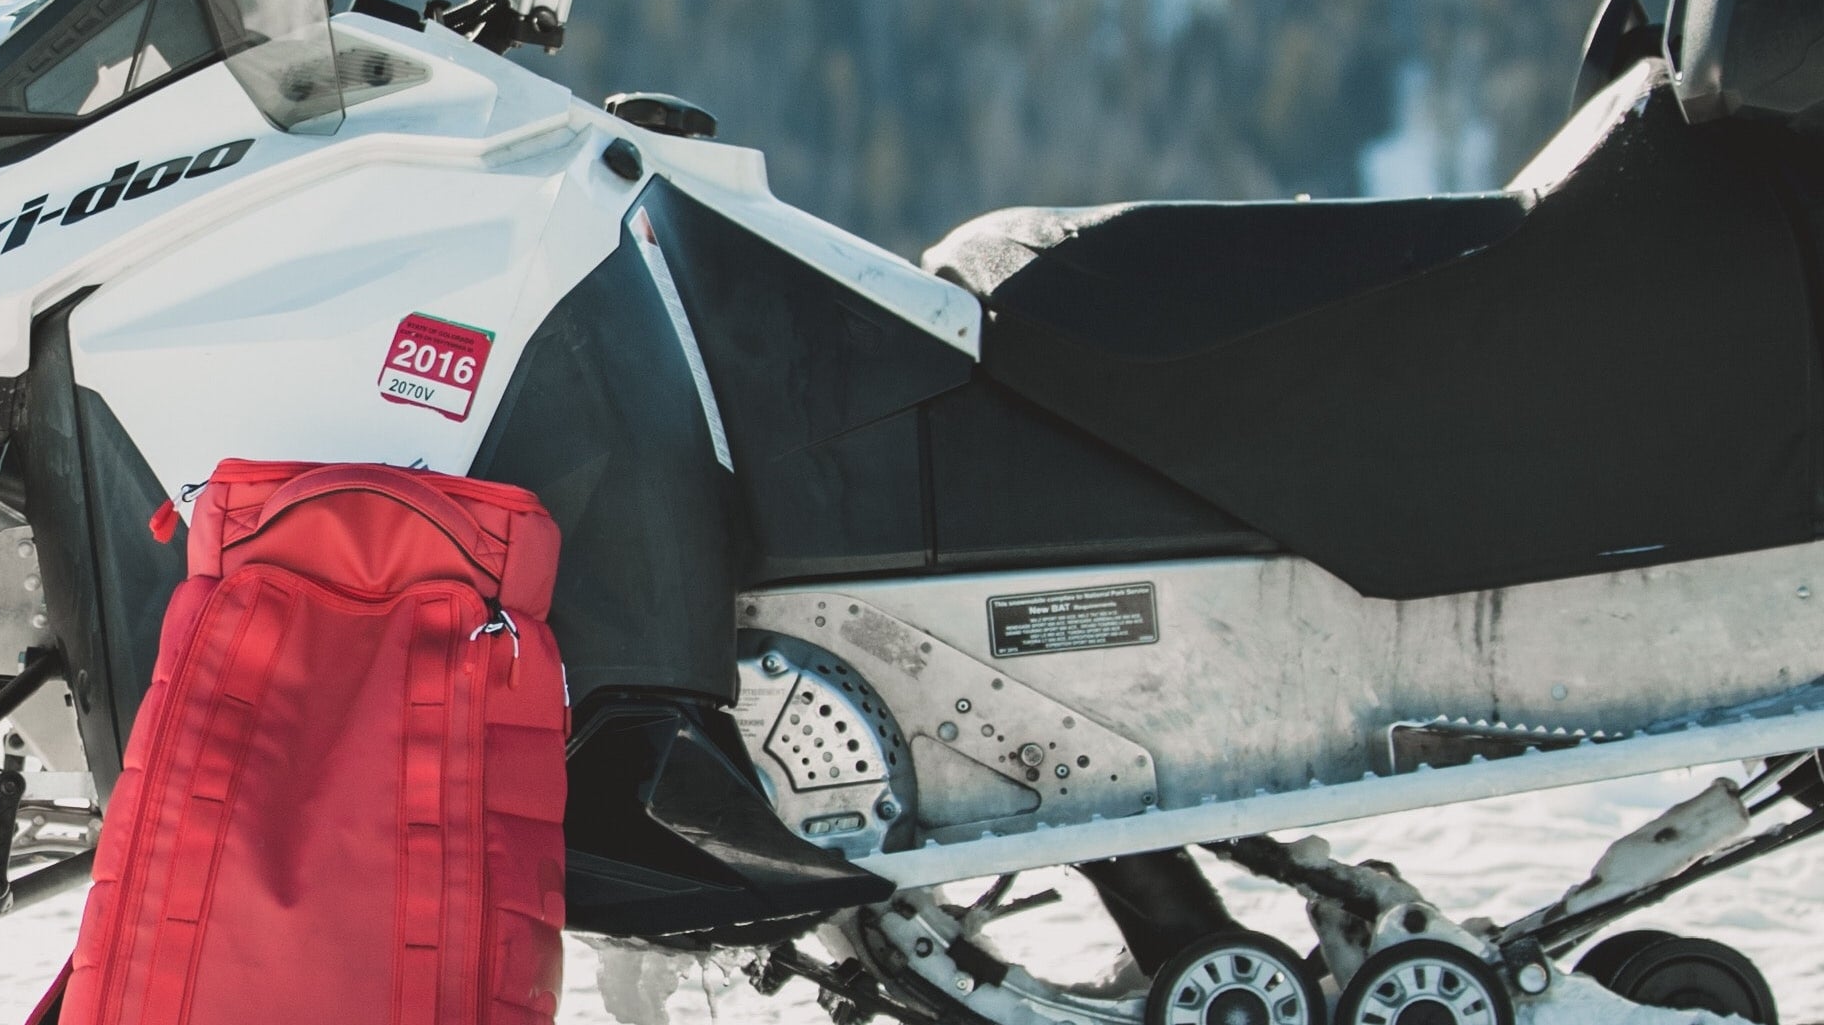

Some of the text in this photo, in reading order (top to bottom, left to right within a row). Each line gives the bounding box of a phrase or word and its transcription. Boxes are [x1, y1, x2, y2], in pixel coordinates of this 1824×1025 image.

[439, 330, 474, 344] COLORADO
[392, 340, 476, 384] 2016
[389, 379, 435, 401] 2070V
[1029, 606, 1049, 614] New
[1051, 604, 1070, 612] BAT
